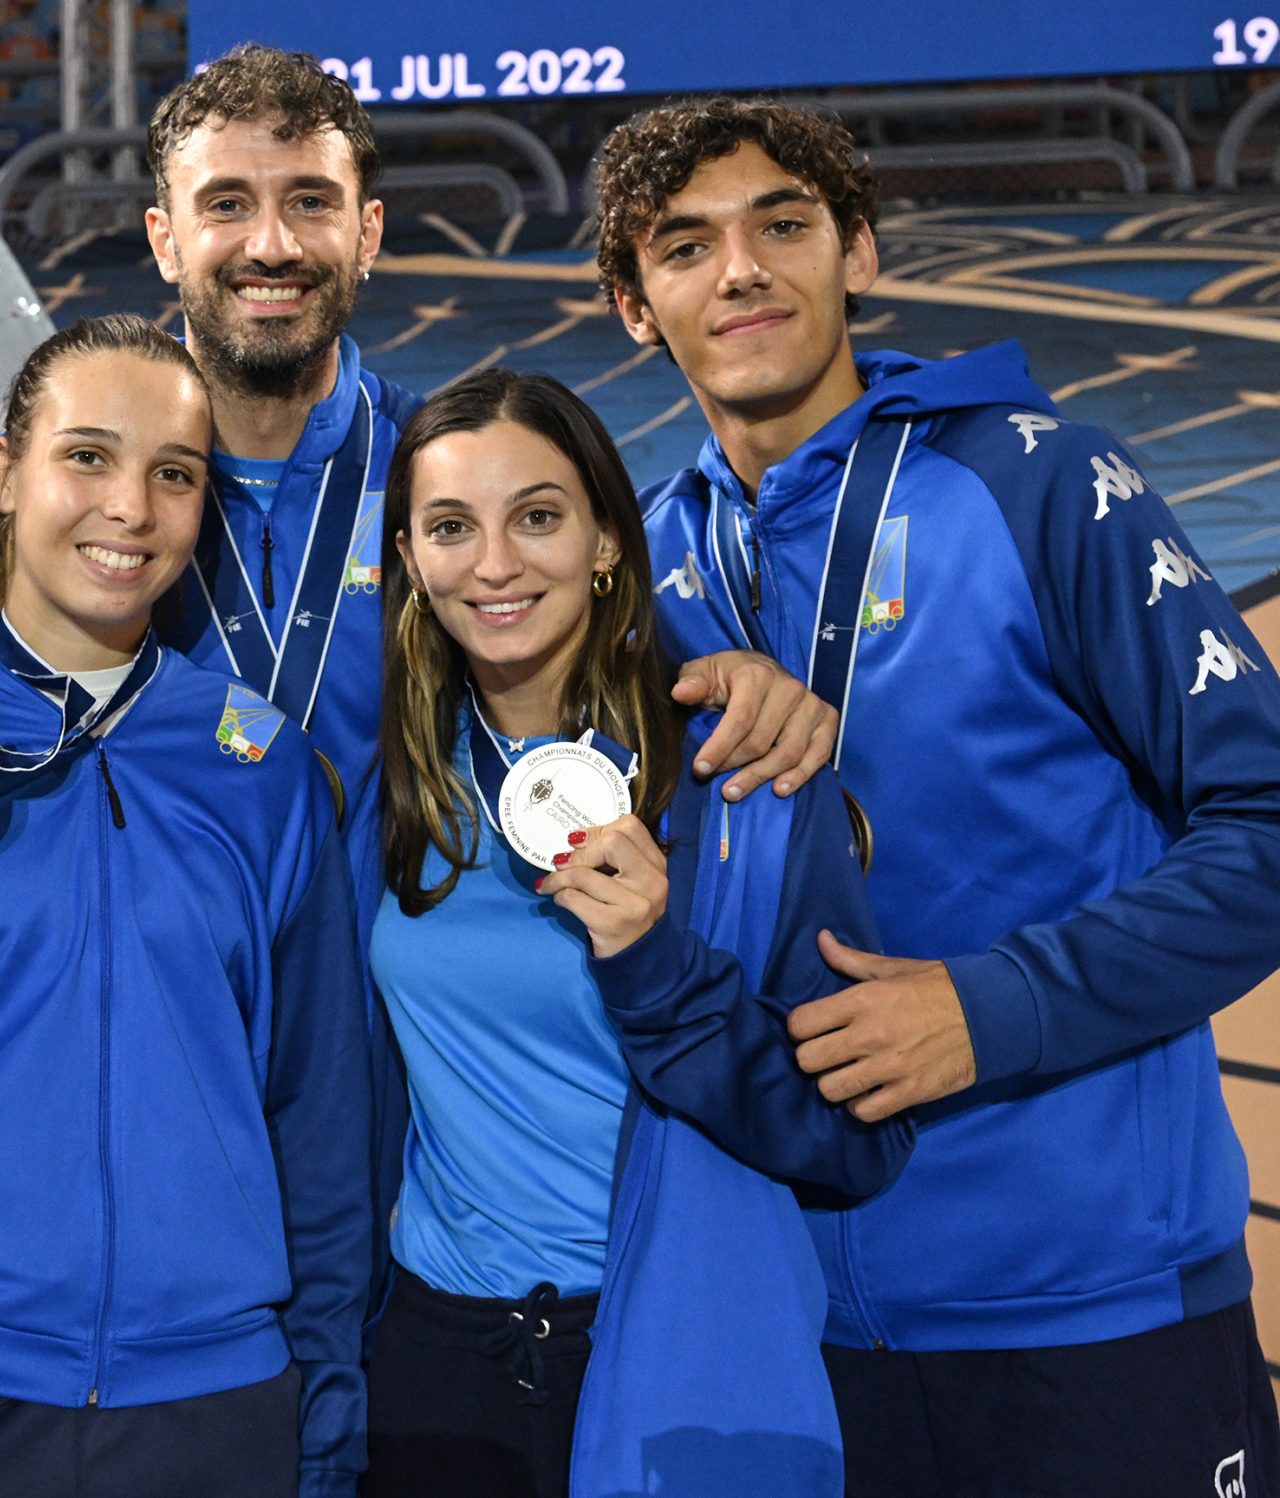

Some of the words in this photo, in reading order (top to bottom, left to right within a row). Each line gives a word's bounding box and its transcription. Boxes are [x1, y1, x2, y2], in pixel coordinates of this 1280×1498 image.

[391, 52, 486, 100] JUL
[496, 46, 626, 97] 2022
[527, 747, 592, 767] CHAMPIONNATS
[594, 757, 606, 769] DU
[606, 768, 624, 797] MONDE
[507, 821, 531, 854] FEMININE
[531, 851, 548, 864] PAR
